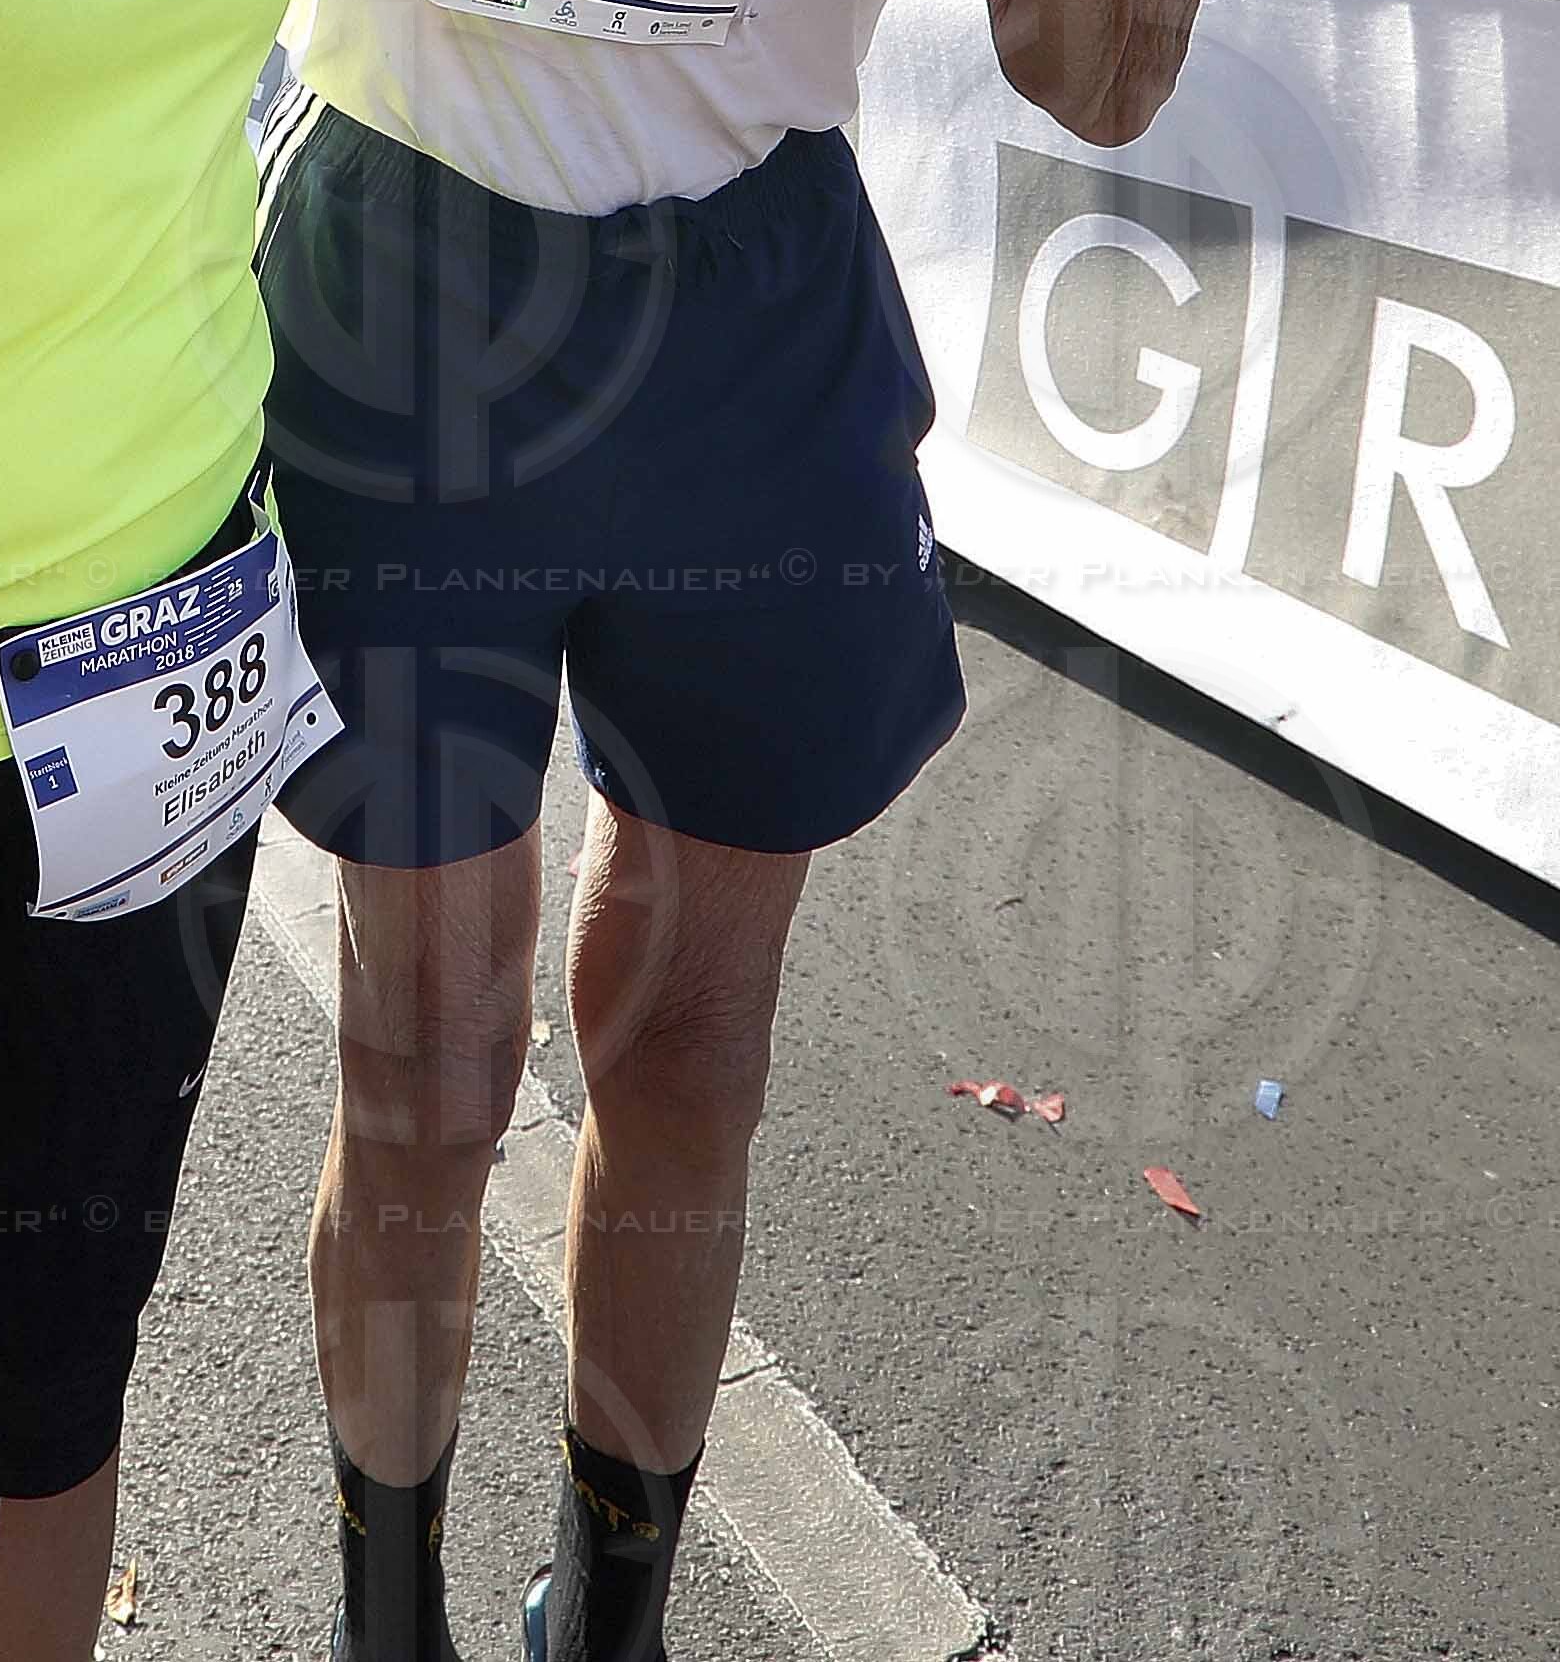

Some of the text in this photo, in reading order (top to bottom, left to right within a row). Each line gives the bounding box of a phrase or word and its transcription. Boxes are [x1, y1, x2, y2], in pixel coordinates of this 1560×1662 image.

[227, 578, 243, 598] 25
[100, 585, 201, 647] GRAZ
[41, 627, 91, 651] KLEINE
[42, 639, 94, 663] ZEITUNG
[80, 631, 178, 676] MARATHON
[155, 644, 195, 671] 2018
[153, 632, 268, 760] 388
[153, 697, 274, 797] Kleine Zeitung Marathon
[28, 756, 70, 780] Startblock
[163, 729, 266, 827] Elisabeth
[47, 775, 59, 790] 1
